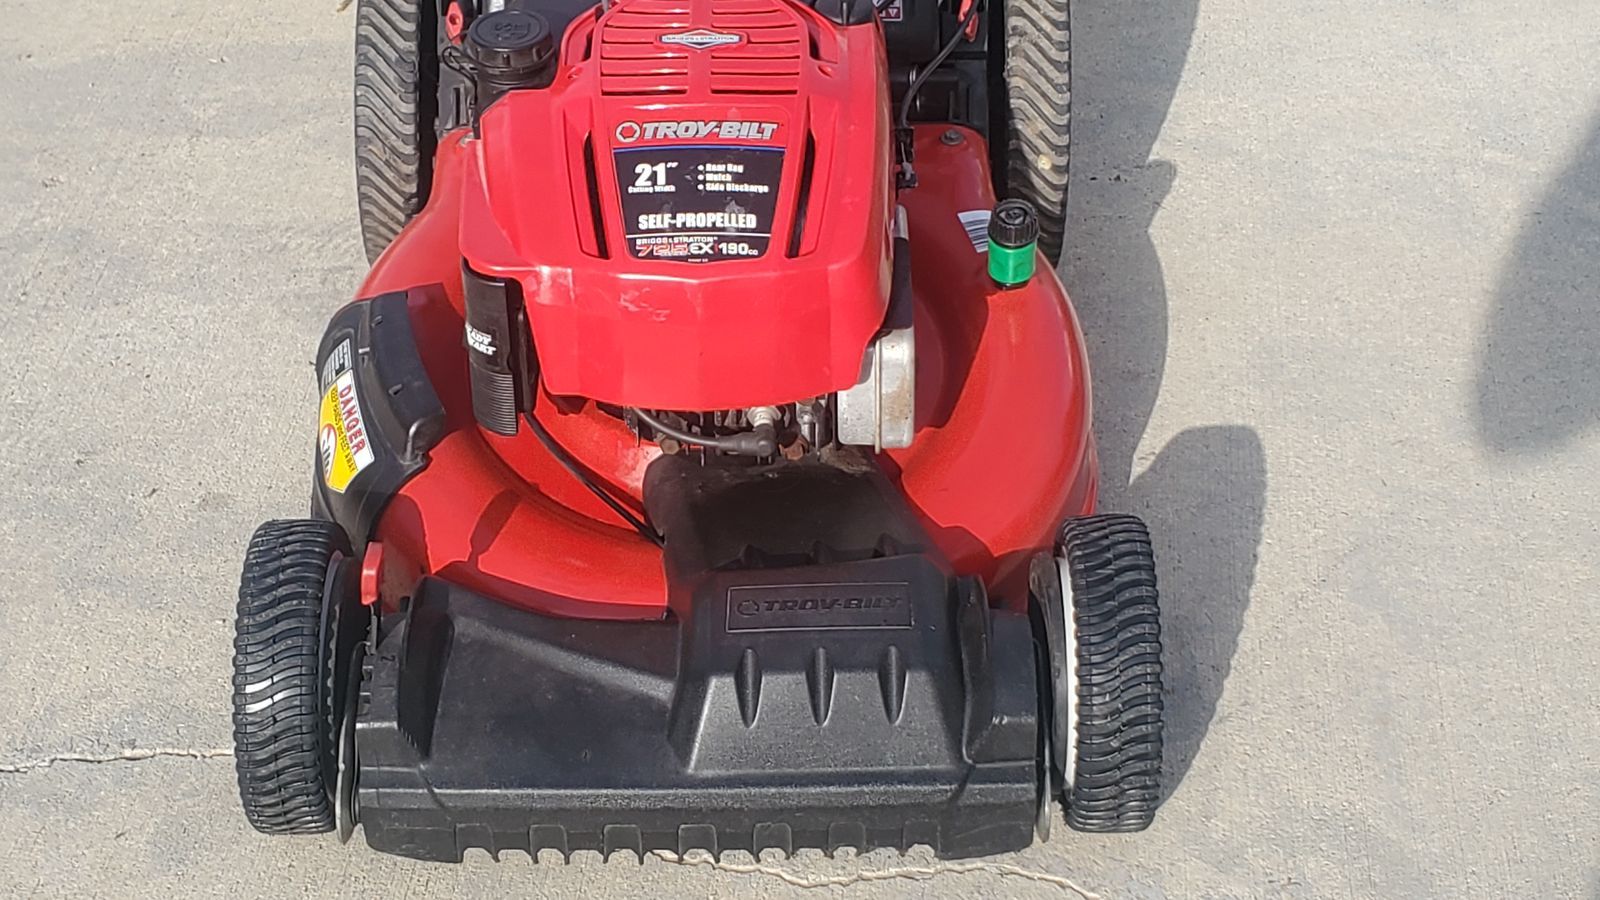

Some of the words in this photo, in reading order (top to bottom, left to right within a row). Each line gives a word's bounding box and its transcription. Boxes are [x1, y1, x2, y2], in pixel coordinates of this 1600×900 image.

[641, 121, 778, 139] TROY-BILT
[705, 183, 725, 191] Side
[638, 212, 757, 230] SELF-PROPELLED
[338, 383, 366, 456] DANGER
[763, 596, 901, 611] TROY-BILT
